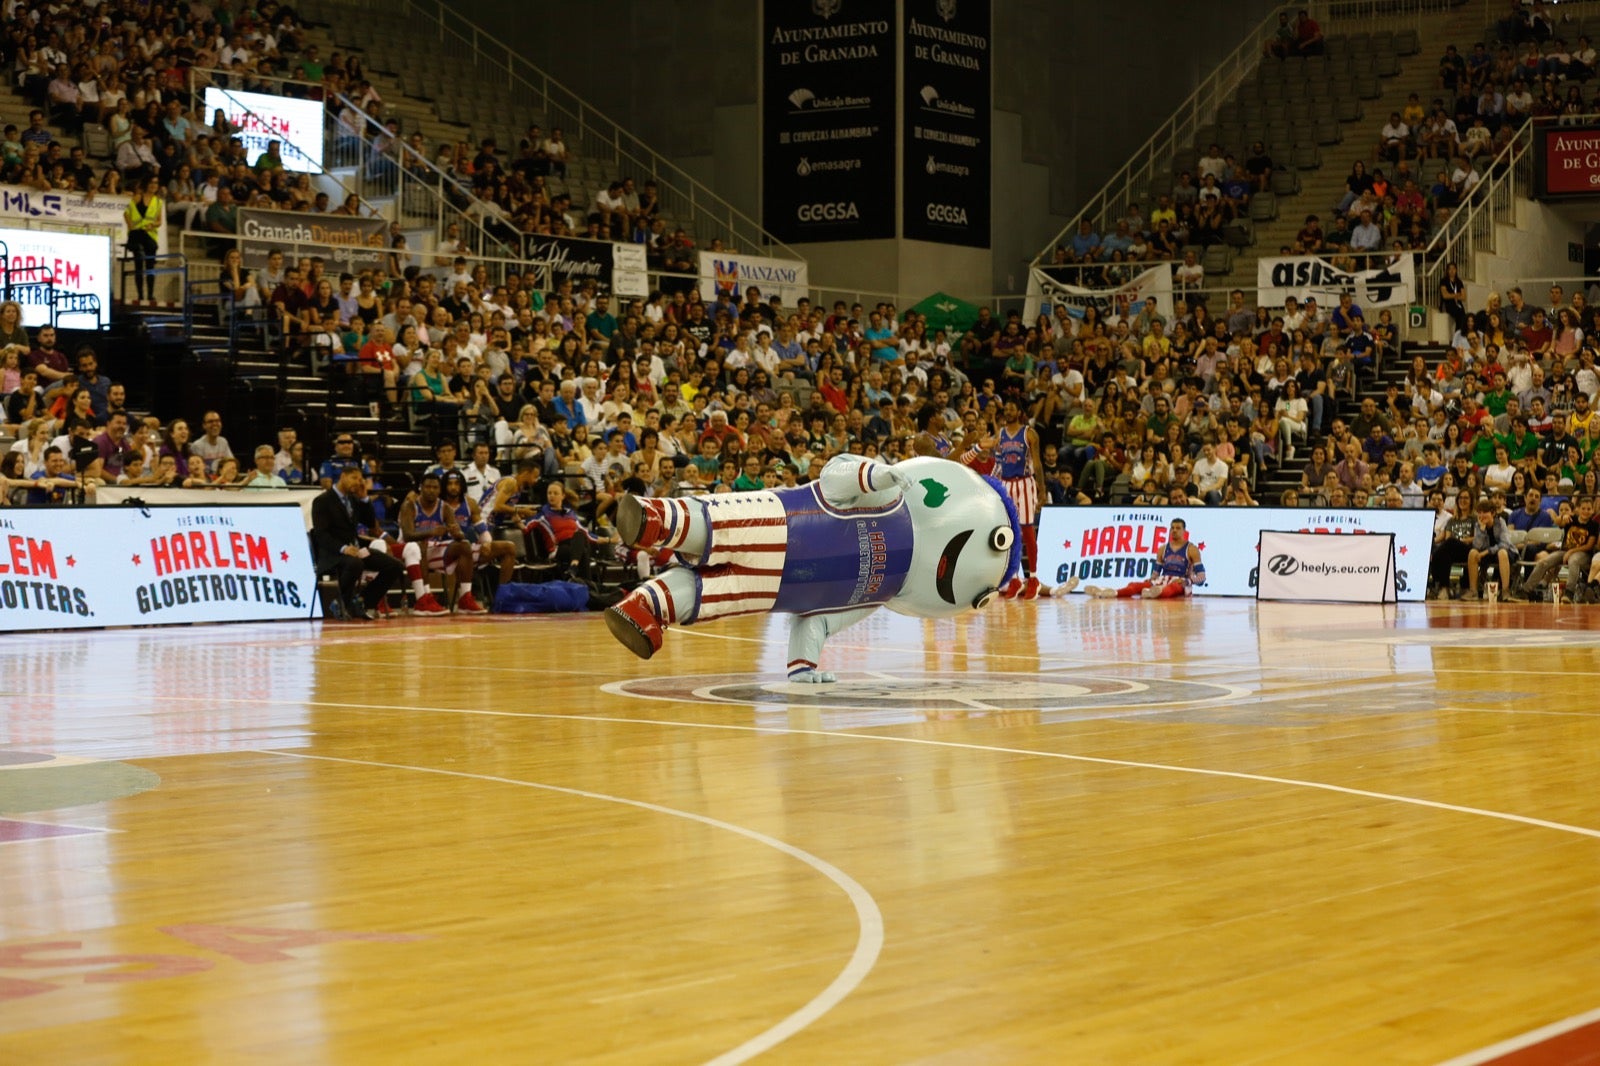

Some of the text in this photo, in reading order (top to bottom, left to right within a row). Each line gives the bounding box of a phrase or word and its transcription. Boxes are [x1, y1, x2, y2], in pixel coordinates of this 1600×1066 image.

[771, 20, 889, 45] AYUNTAMIENTO
[908, 17, 987, 50] AYUNTAMIENTO
[780, 44, 879, 65] DE GRANADA
[915, 43, 980, 70] DE GRANADA
[792, 130, 829, 142] CERVEZAS
[1563, 157, 1582, 169] DE
[740, 264, 796, 283] MANZANO
[1411, 312, 1422, 328] D
[1129, 514, 1163, 522] ORIGINAL
[1081, 525, 1189, 557] HARLE
[150, 530, 273, 576] HARLEM
[863, 531, 887, 594] HARLEM
[1301, 562, 1380, 575] heelys.eu.com
[0, 580, 94, 617] OTTERS.
